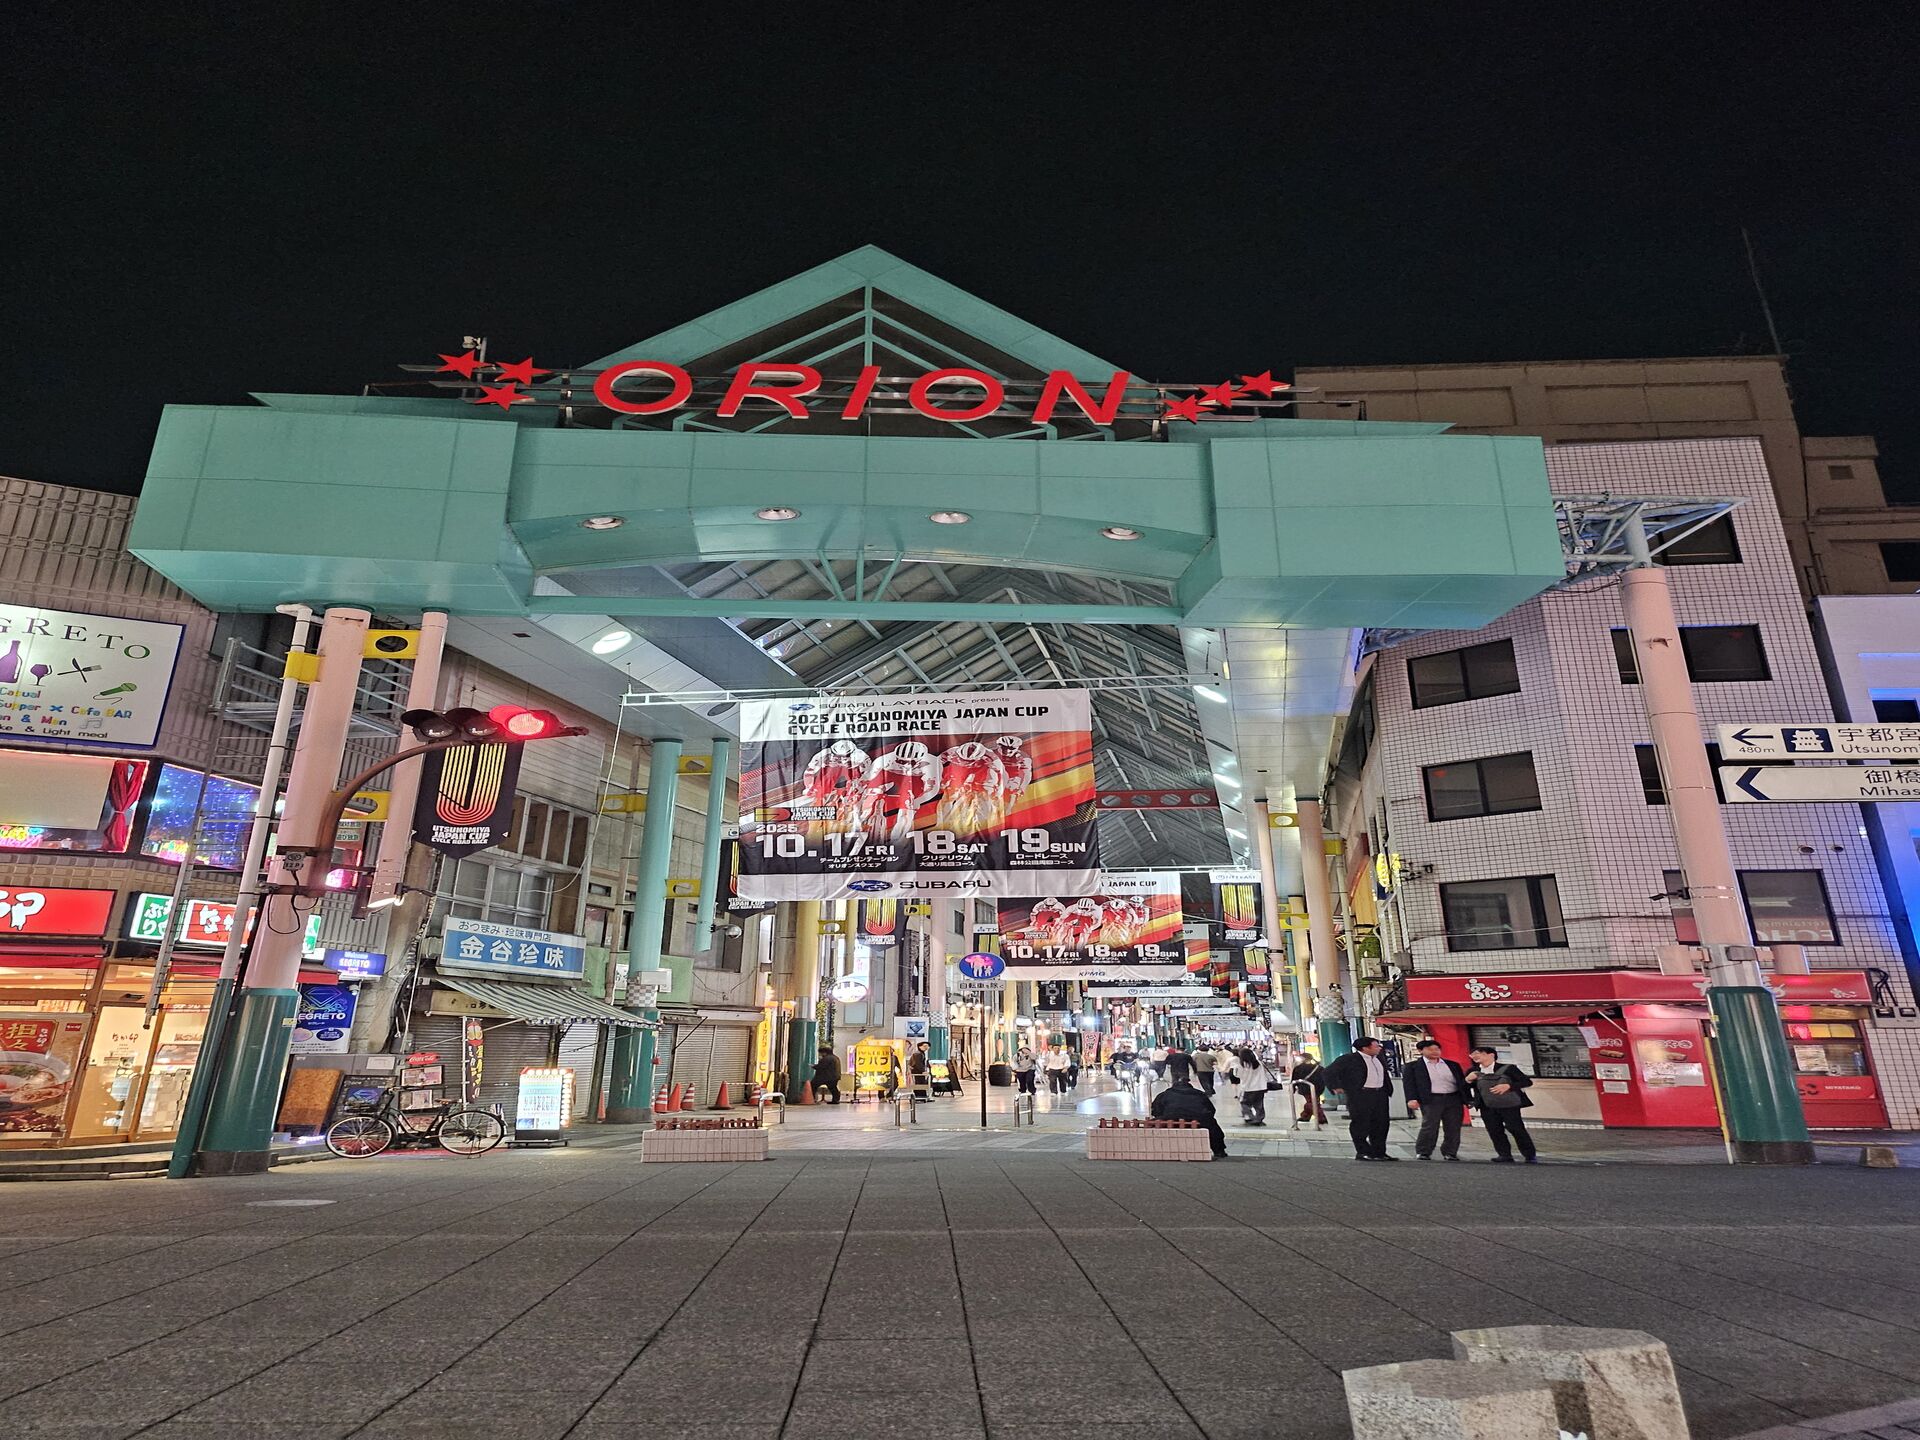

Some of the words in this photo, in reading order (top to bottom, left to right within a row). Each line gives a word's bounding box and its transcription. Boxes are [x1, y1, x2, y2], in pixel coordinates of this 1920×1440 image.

[594, 361, 1131, 425] ORION
[881, 698, 965, 707] LAYBACK
[71, 706, 101, 716] Cafe
[106, 708, 132, 718] BAR
[788, 713, 829, 724] 2025
[835, 709, 948, 722] UTSUNOMIYA
[953, 707, 1008, 719] JAPAN
[1015, 706, 1049, 716] CUP
[41, 716, 67, 726] Men
[788, 724, 839, 735] CYCLE
[846, 722, 890, 733] ROAD
[897, 720, 941, 731] RACE
[1838, 728, 1920, 742] 宇都宮
[1841, 744, 1920, 753] Utsunom
[433, 825, 490, 833] UTSUNOMIYA
[756, 824, 798, 832] 2025
[865, 845, 895, 855] FRI
[906, 830, 956, 854] 18
[957, 843, 988, 854] SAT
[1001, 828, 1049, 853] 19
[1050, 842, 1086, 853] SUN
[899, 879, 992, 890] SUBARU
[460, 935, 564, 968] 金谷珍味
[1085, 944, 1111, 956] 18
[1134, 944, 1160, 956] 19
[1465, 978, 1512, 1000] 宮たこ
